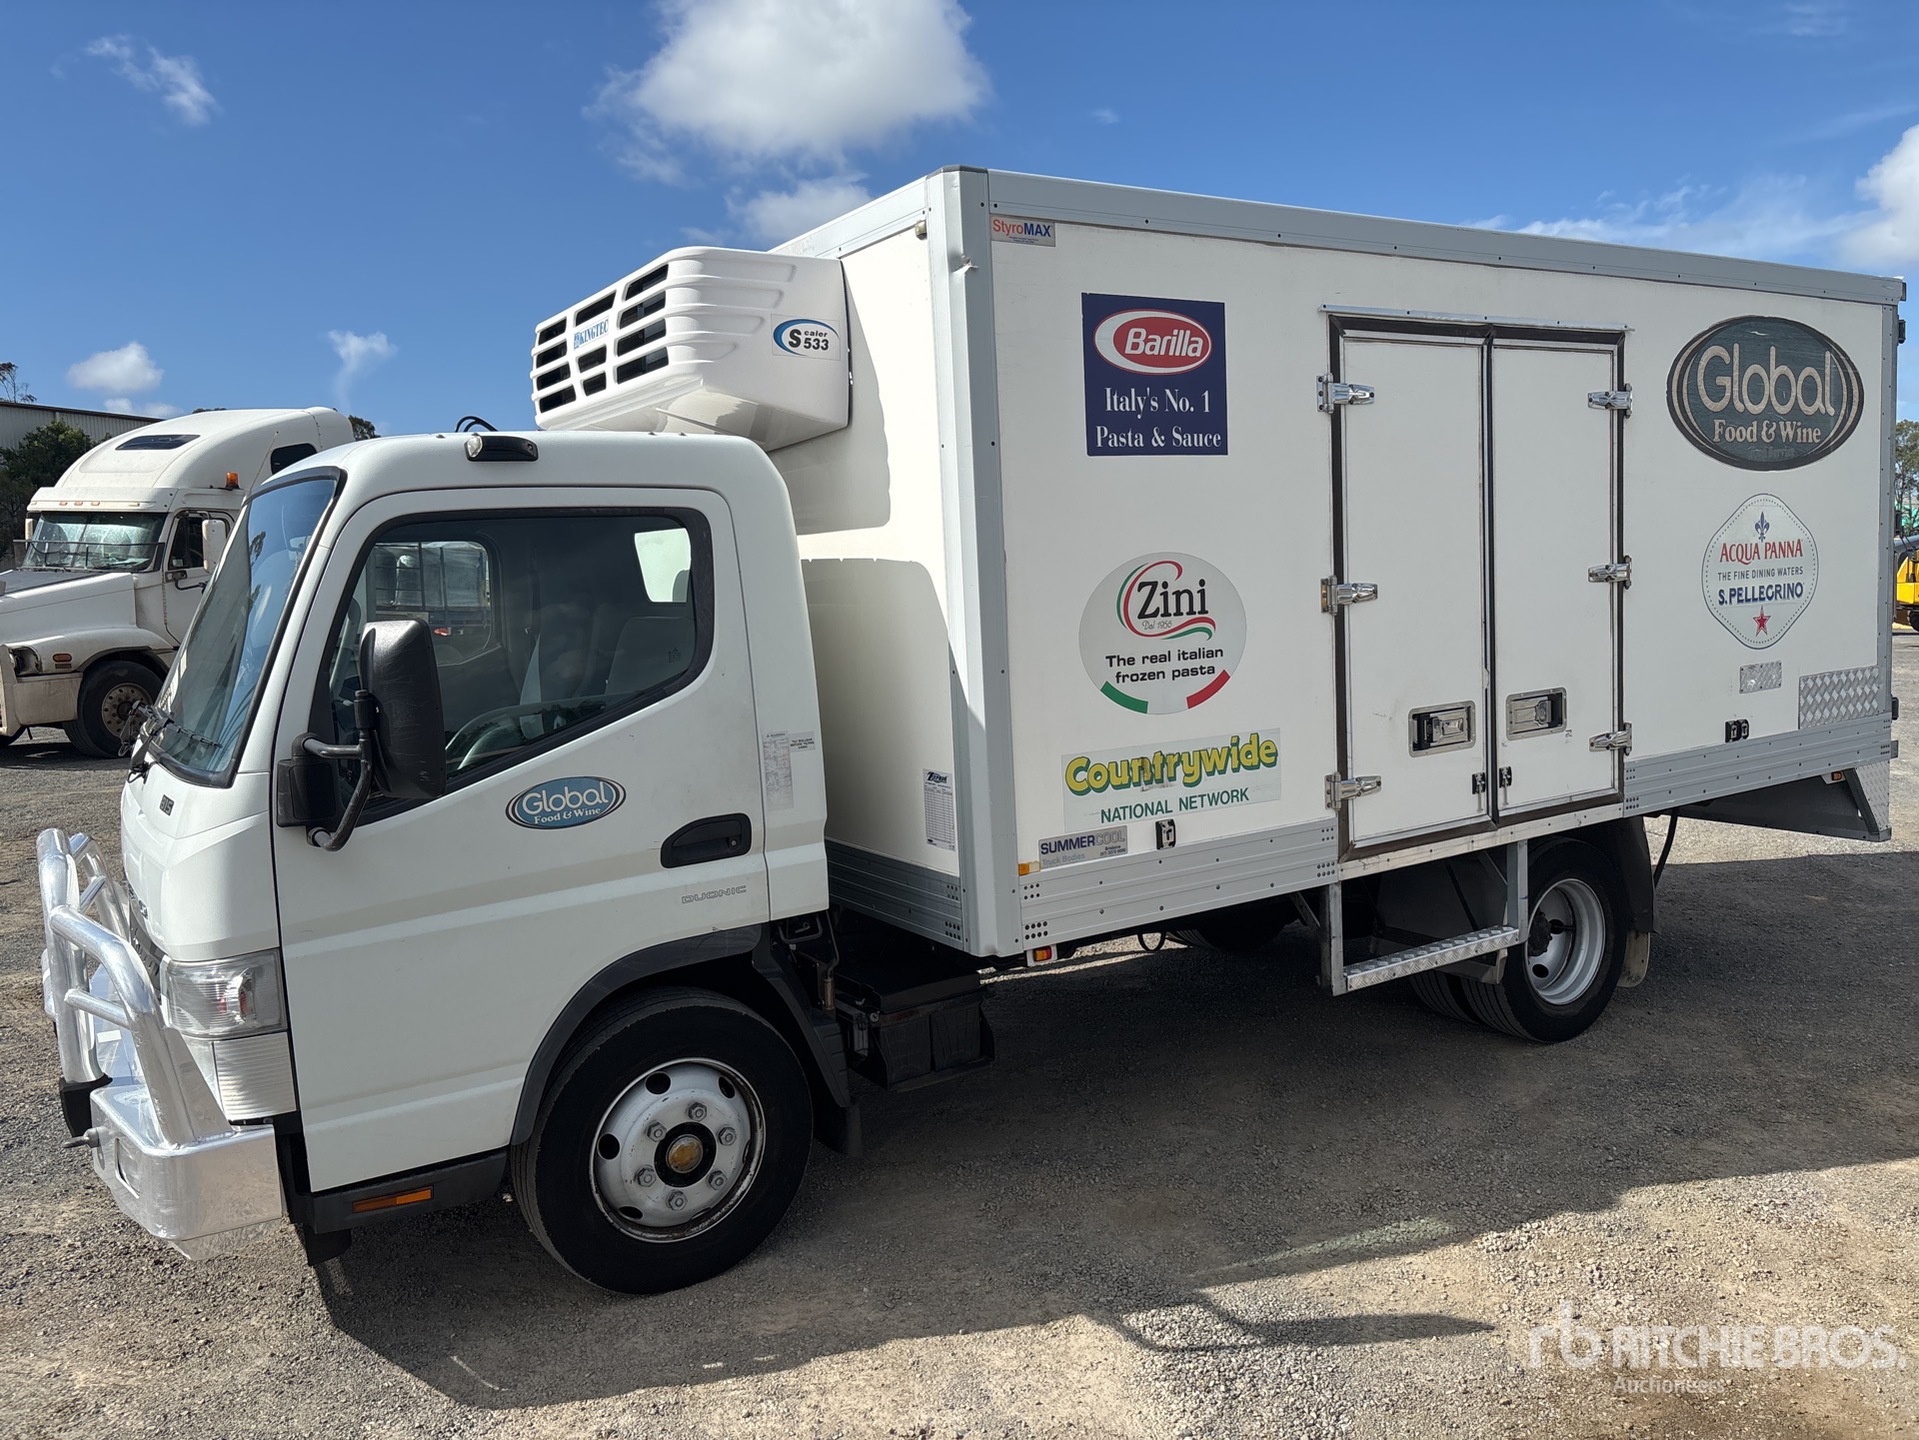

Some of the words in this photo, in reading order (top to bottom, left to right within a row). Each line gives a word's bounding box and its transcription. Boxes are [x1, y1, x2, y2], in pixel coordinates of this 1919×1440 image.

[992, 218, 1052, 238] StyroMAX
[580, 318, 609, 346] KINGTEC
[803, 337, 830, 351] 533
[1124, 327, 1203, 358] Barilla
[1697, 342, 1836, 417] Global
[1104, 387, 1159, 420] Italy's
[1164, 388, 1195, 413] No.
[1201, 389, 1211, 413] 1
[1095, 425, 1145, 448] Pasta
[1151, 426, 1166, 448] &
[1171, 425, 1222, 448] Sauce
[1712, 419, 1758, 443] Food
[1761, 419, 1777, 443] &
[1779, 420, 1822, 444] Wine
[1719, 542, 1761, 566] ACQUA
[1764, 538, 1804, 560] PANNA
[1717, 571, 1732, 582] THE
[1733, 569, 1750, 580] FINE
[1751, 568, 1776, 579] DINING
[1777, 566, 1804, 577] WATERS
[1137, 578, 1209, 619] Zini
[1105, 655, 1136, 668] The
[1141, 650, 1172, 665] real
[1177, 646, 1224, 662] italian
[1115, 670, 1166, 684] frozen
[1171, 664, 1216, 681] pasta
[1065, 732, 1279, 797] Countrywide
[522, 781, 609, 815] Global
[1100, 799, 1174, 824] NATIONAL
[1178, 787, 1249, 812] NETWORK
[534, 813, 561, 824] Food
[562, 810, 572, 819] &
[573, 807, 601, 818] Wine
[1040, 830, 1126, 855] SUMMERCOOL
[681, 885, 747, 904] DUONIC
